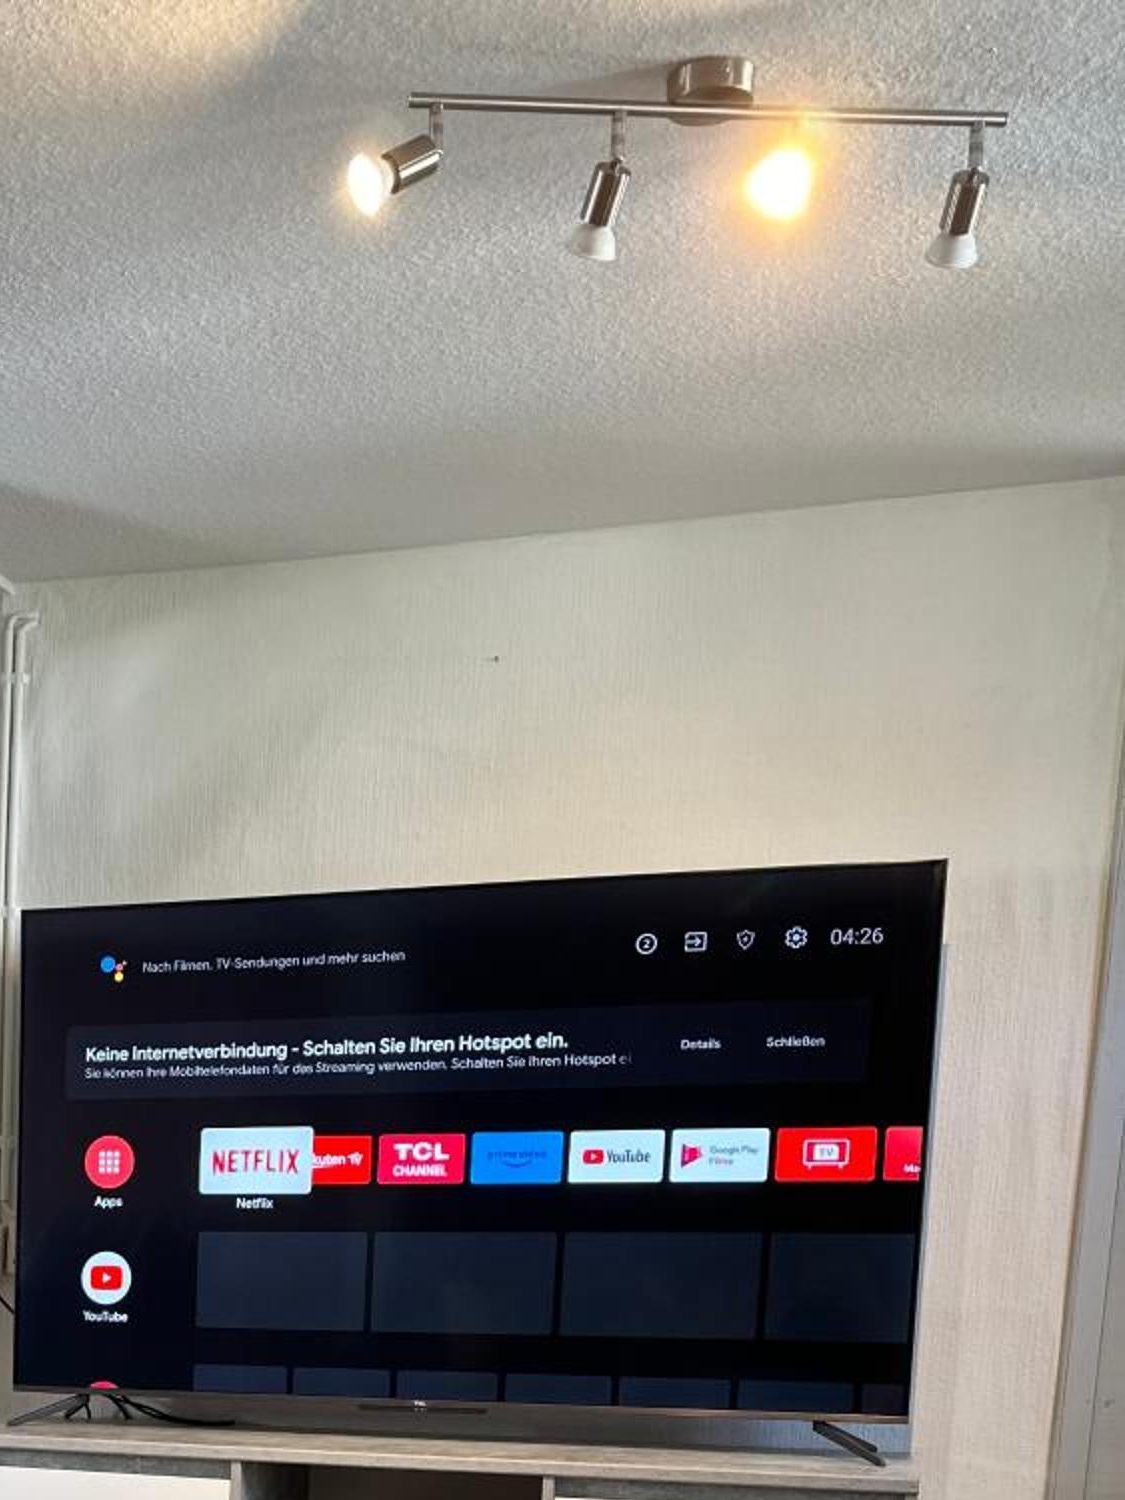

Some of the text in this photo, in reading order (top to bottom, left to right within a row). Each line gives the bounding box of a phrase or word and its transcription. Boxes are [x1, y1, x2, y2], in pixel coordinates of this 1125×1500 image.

[830, 927, 884, 945] 04:26
[142, 961, 171, 973] Nach
[216, 956, 300, 971] TV-Sendungen
[302, 954, 325, 967] und
[327, 952, 359, 965] mehr
[362, 950, 406, 963] suchen
[86, 1046, 129, 1062] Keine
[132, 1040, 288, 1061] Internetverbindung
[303, 1038, 376, 1056] Schalten
[379, 1037, 406, 1053] Sie
[410, 1035, 455, 1052] Ihren
[458, 1033, 532, 1054] Hotspot
[535, 1031, 569, 1049] ein.
[680, 1038, 721, 1051] Details
[766, 1035, 825, 1049] Schließen
[85, 1067, 101, 1079] Sie
[103, 1066, 143, 1078] können
[146, 1065, 167, 1077] Ihre
[169, 1063, 270, 1077] Mobiltelefondaten
[273, 1063, 289, 1075] für
[292, 1062, 313, 1074] das
[315, 1061, 375, 1075] Streaming
[378, 1059, 447, 1072] verwenden.
[451, 1056, 504, 1070] Schalten
[506, 1055, 525, 1068] Sie
[528, 1054, 561, 1068] Ihren
[564, 1053, 617, 1068] Hotspot
[347, 1151, 363, 1166] TV
[393, 1142, 450, 1161] TCL
[607, 1149, 651, 1163] YouTube
[820, 1146, 835, 1157] TV
[212, 1149, 300, 1174] NETFLIX
[392, 1165, 447, 1177] CHANNEL
[94, 1195, 123, 1208] Apps
[236, 1198, 273, 1209] Netflix
[83, 1310, 128, 1322] YouTube
